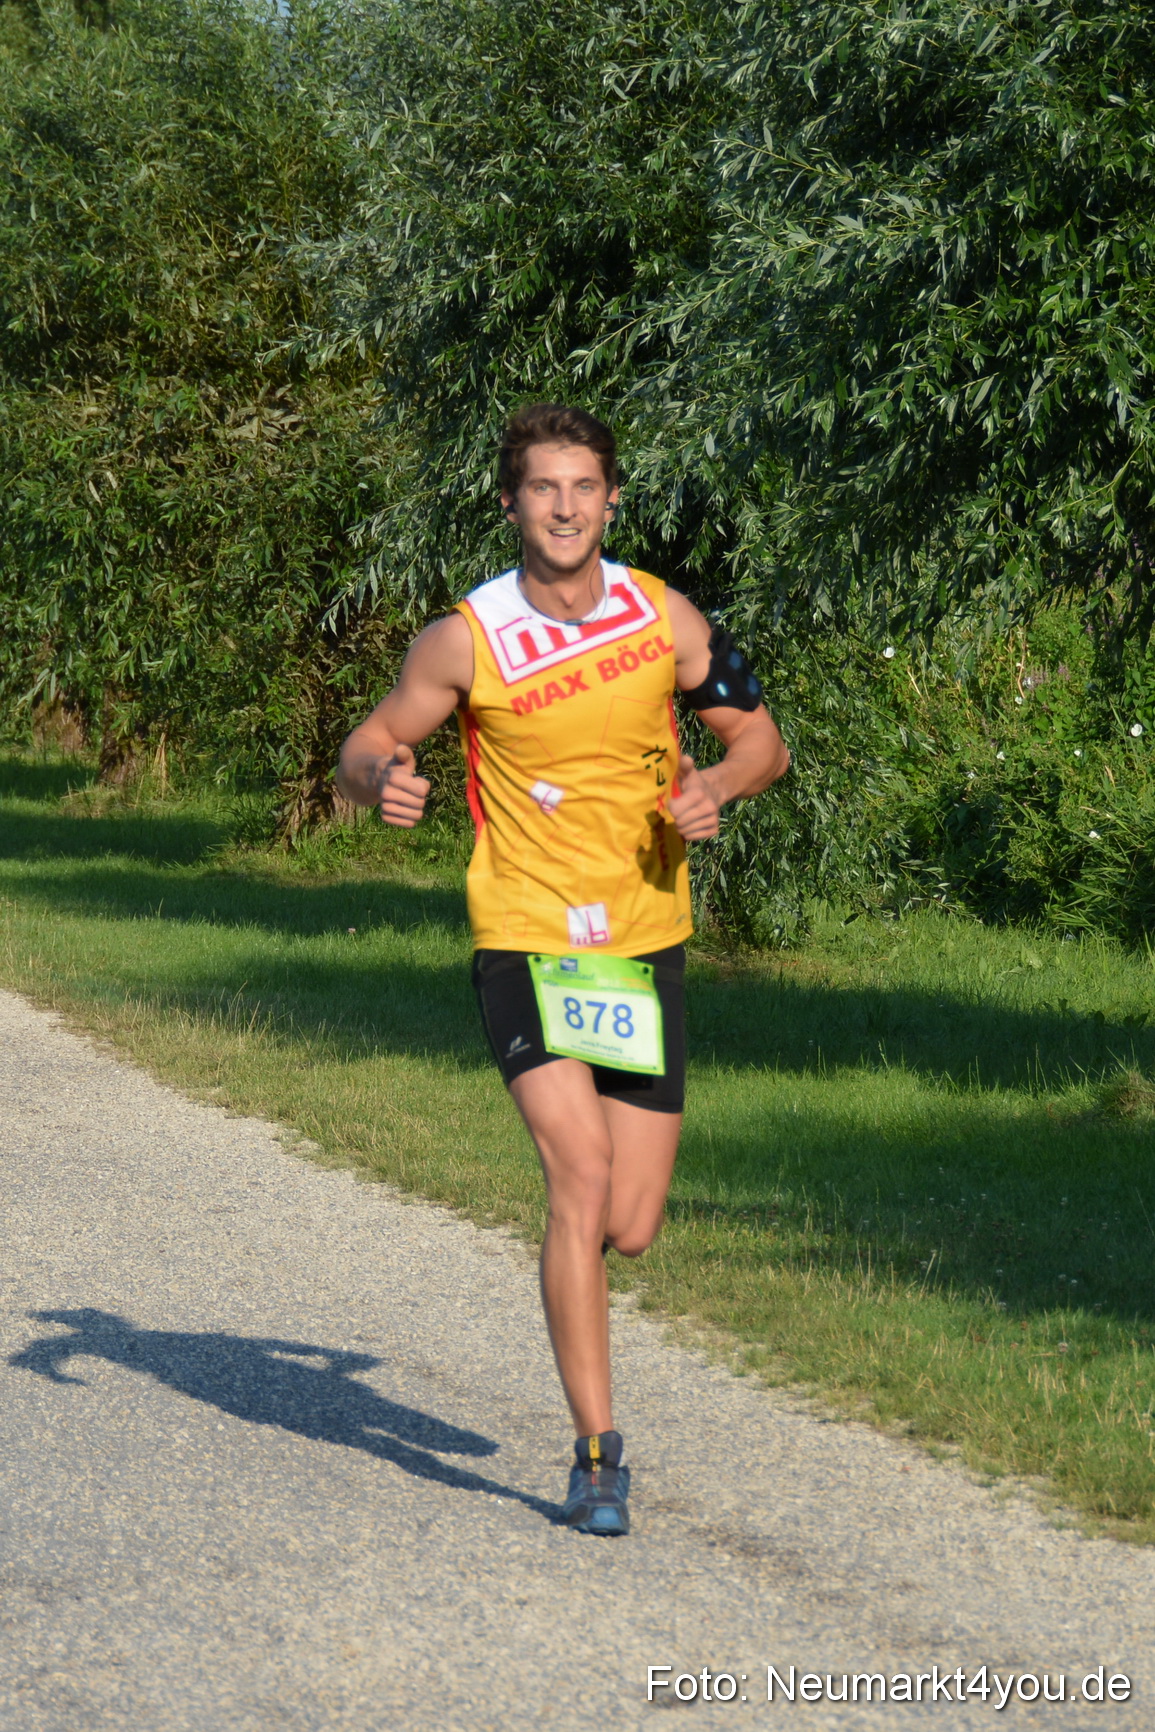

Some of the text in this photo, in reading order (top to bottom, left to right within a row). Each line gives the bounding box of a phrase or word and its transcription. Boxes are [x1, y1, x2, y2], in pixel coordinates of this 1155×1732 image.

[510, 635, 674, 717] MAX BÖGL
[563, 996, 635, 1039] 878
